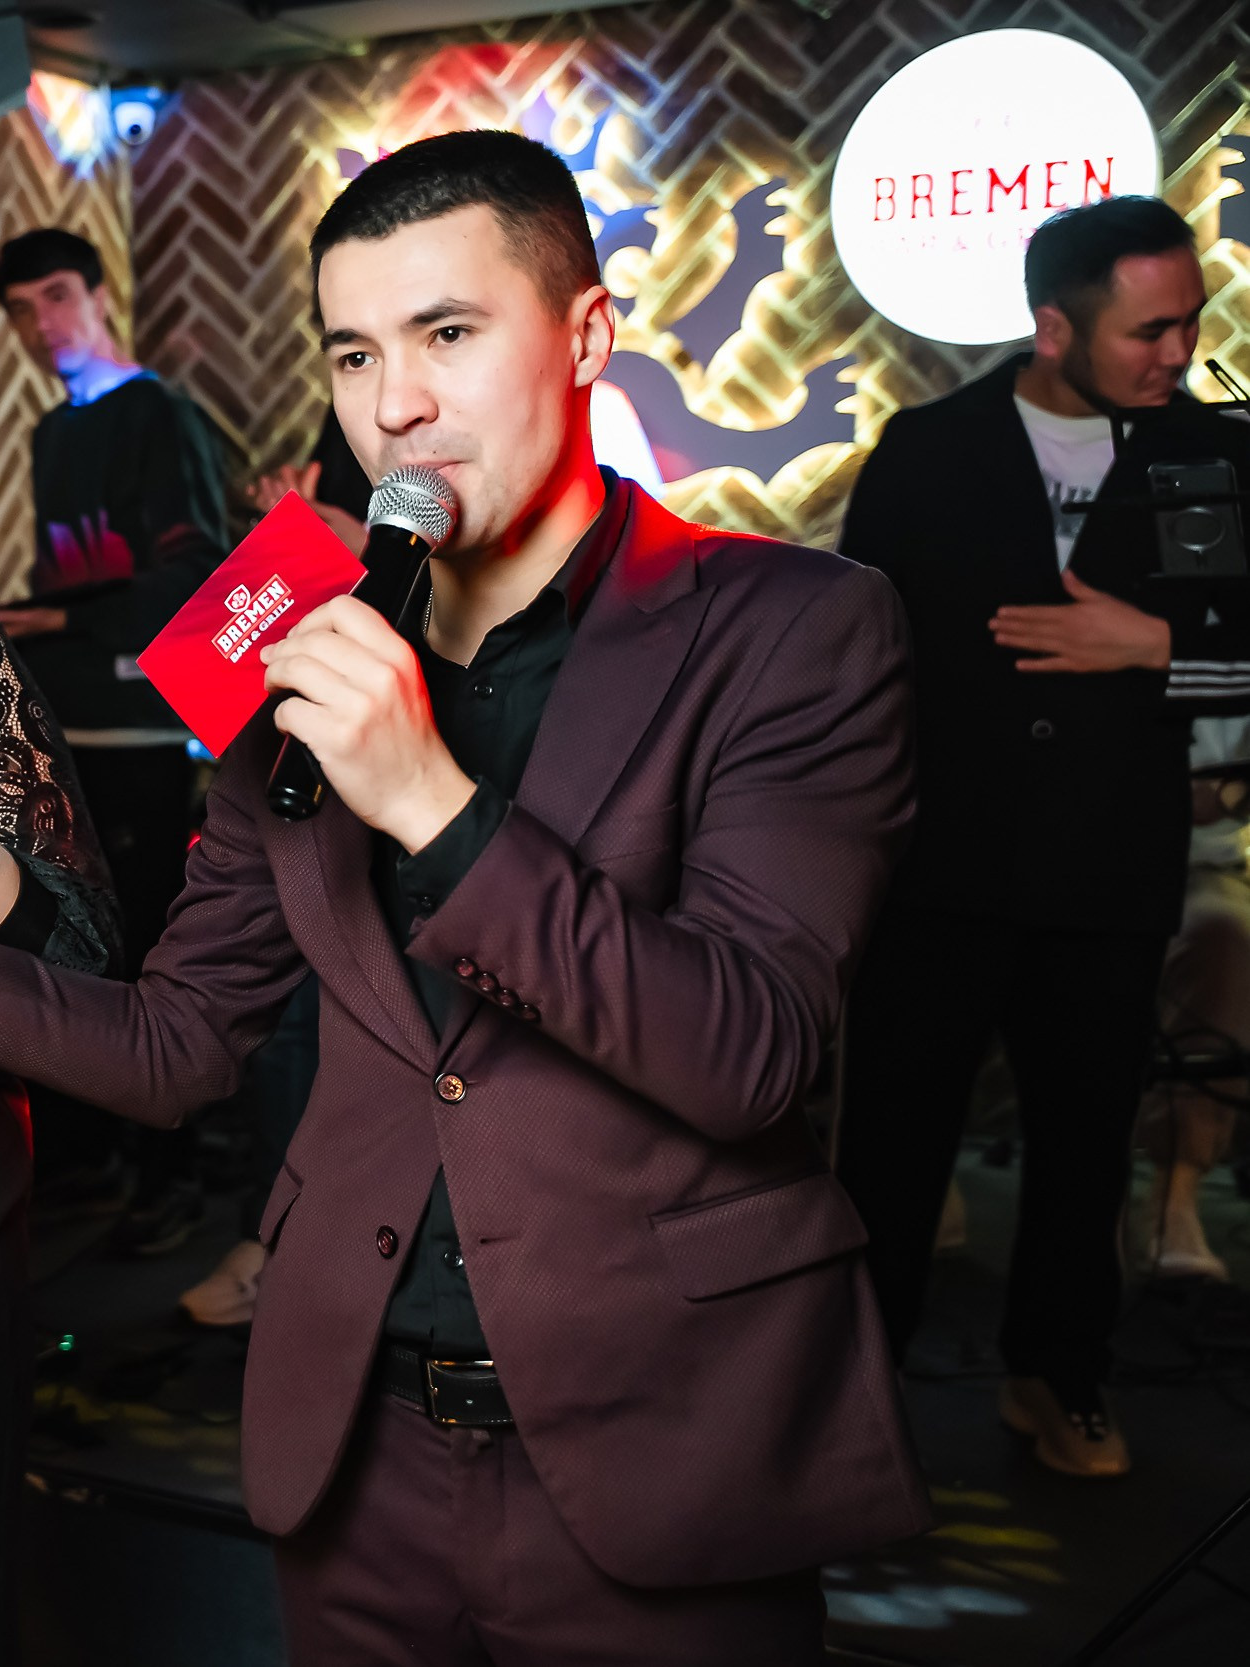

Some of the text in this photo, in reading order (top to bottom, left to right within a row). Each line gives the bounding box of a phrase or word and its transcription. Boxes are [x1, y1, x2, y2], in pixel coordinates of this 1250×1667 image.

[873, 156, 1114, 222] BREMEN
[216, 580, 285, 653] BREMEN
[229, 597, 296, 664] BAR & GRILL
